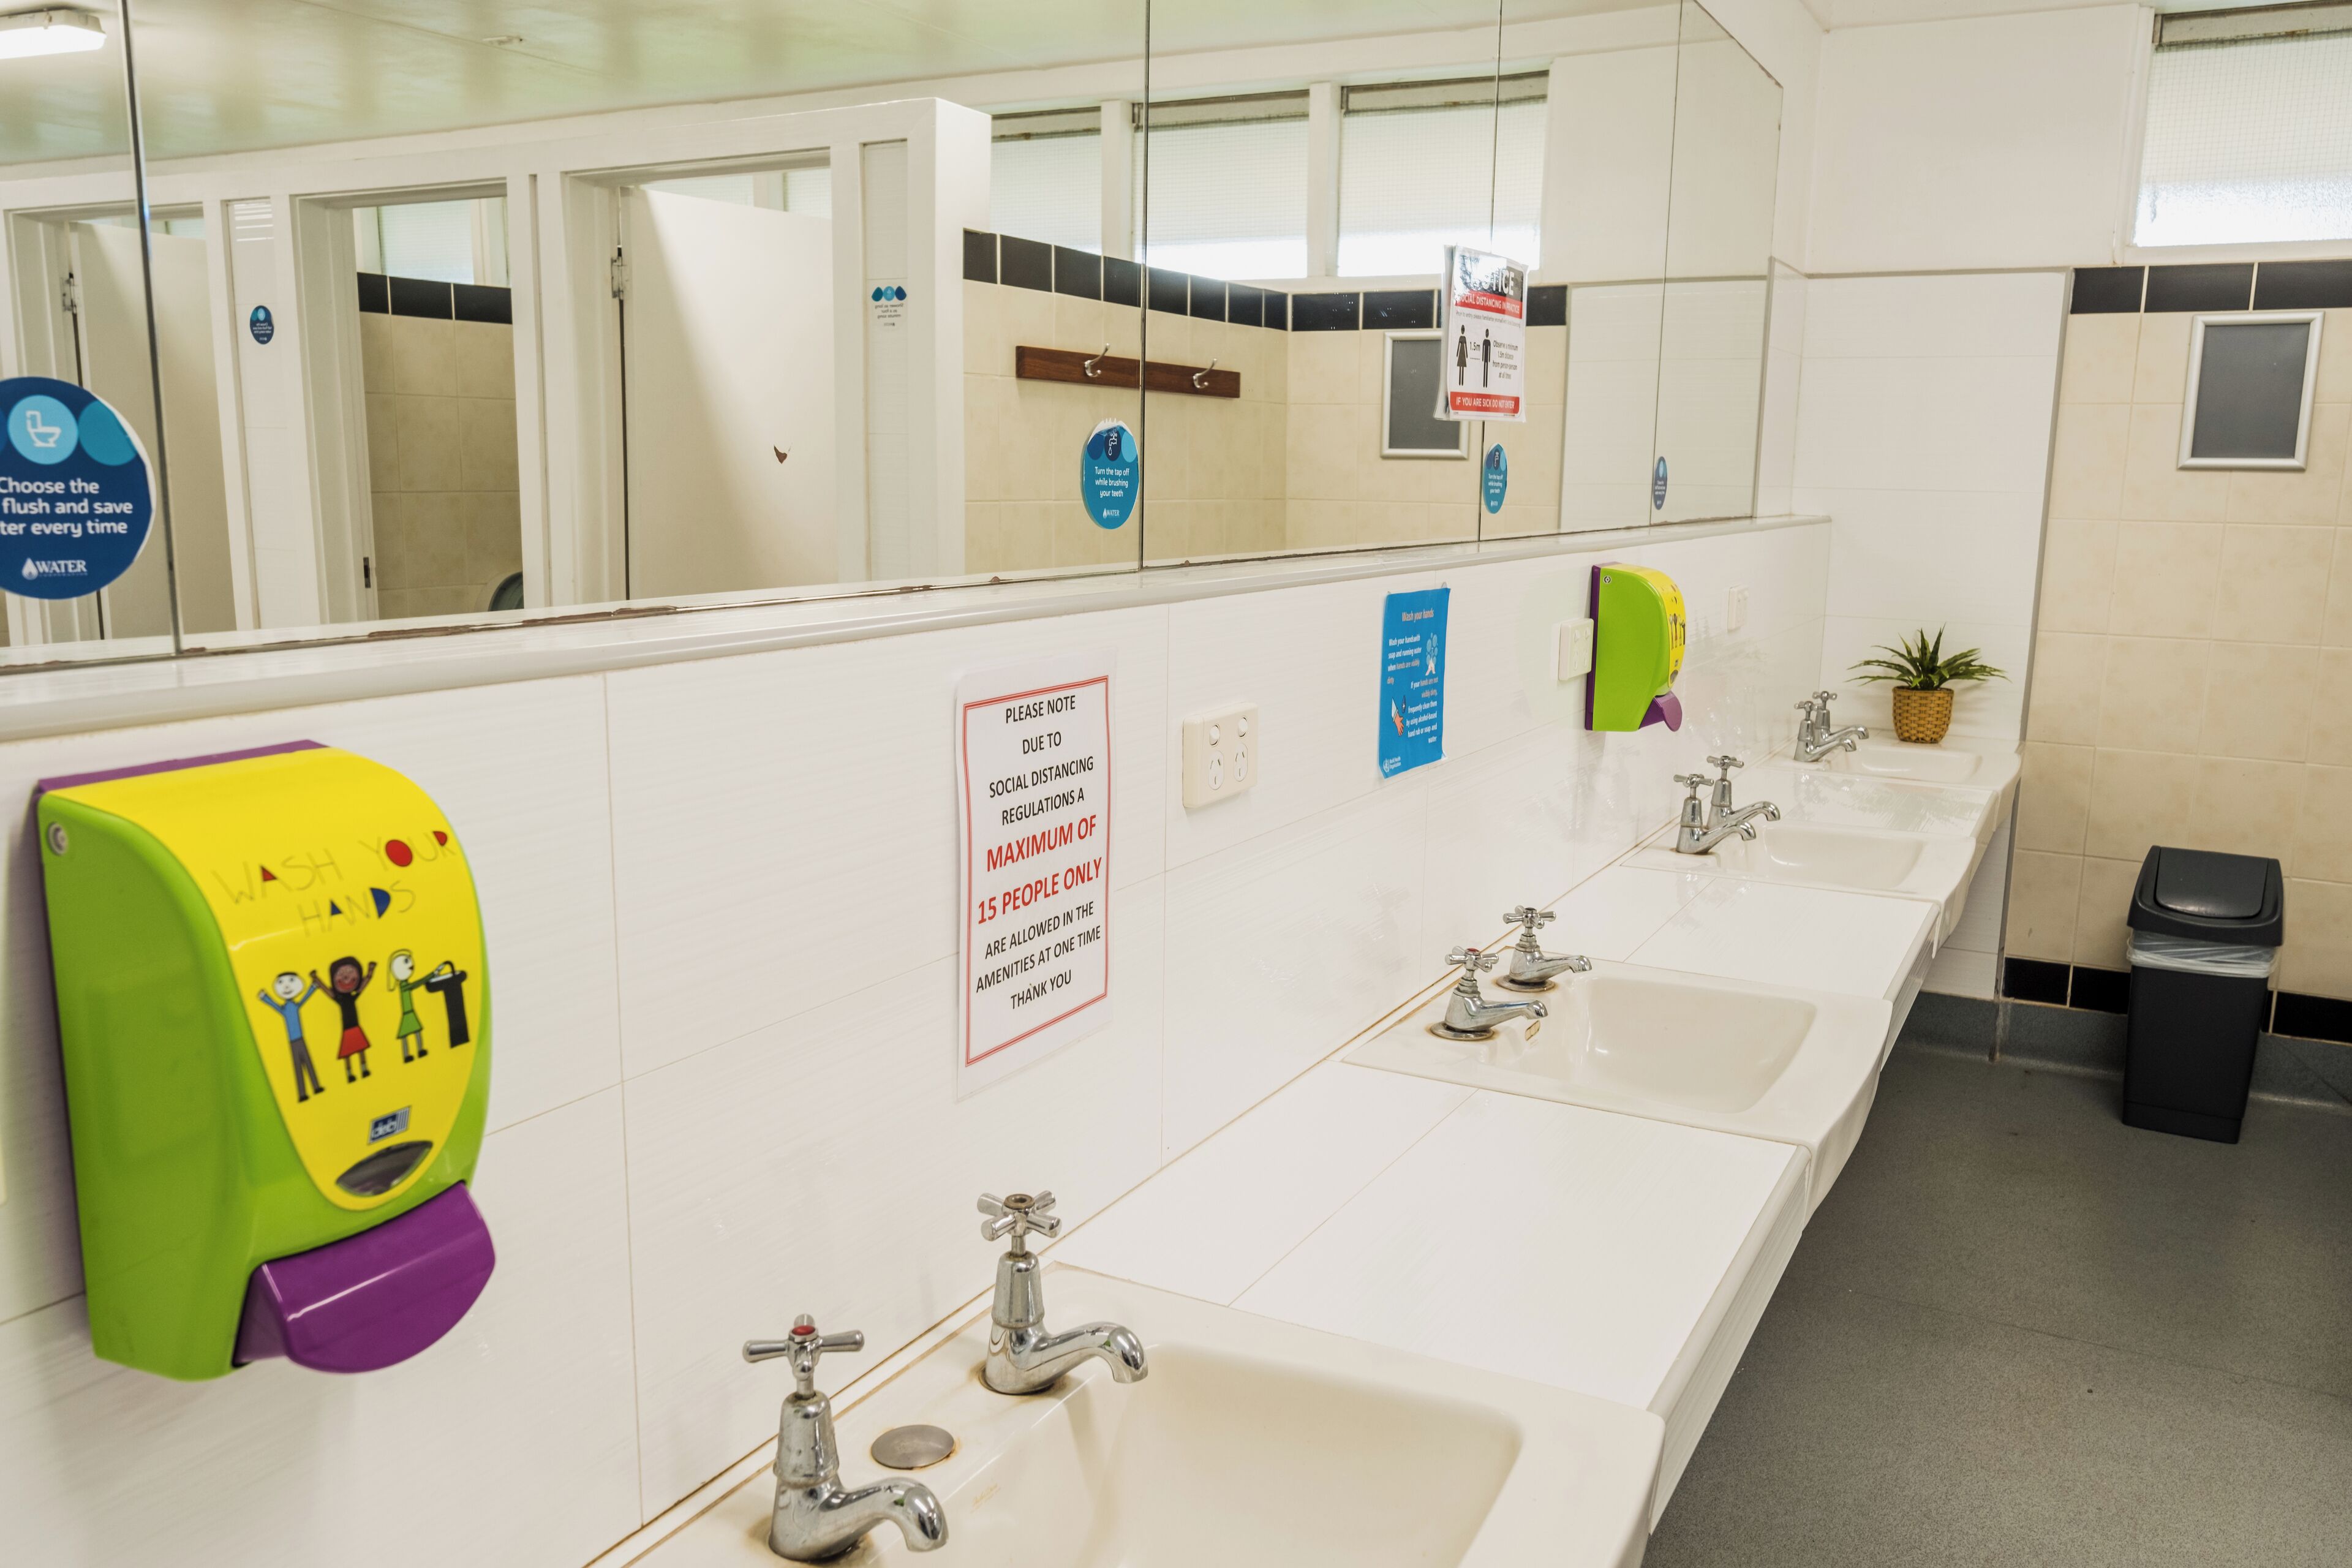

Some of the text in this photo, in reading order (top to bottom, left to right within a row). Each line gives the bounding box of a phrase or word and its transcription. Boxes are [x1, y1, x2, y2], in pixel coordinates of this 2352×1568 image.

[1474, 268, 1515, 296] OTICE
[1476, 296, 1502, 309] DISTANCING
[1502, 301, 1506, 310] IN
[1506, 302, 1520, 314] PRACTICE
[1470, 342, 1480, 351] 1.5m
[1456, 397, 1461, 405] IF
[1462, 398, 1472, 407] YOU
[1473, 398, 1482, 407] ARE
[1482, 399, 1491, 407] SICK
[1492, 399, 1498, 408] DO
[1505, 401, 1514, 409] ENTER
[0, 477, 100, 494] Choose the
[1109, 478, 1128, 488] brushing
[1112, 489, 1123, 497] teeth
[2, 497, 133, 514] flush and save
[0, 519, 127, 538] ter every time
[36, 560, 87, 573] WATER
[1402, 608, 1434, 622] Wash your hands
[1405, 635, 1414, 644] hands
[1403, 648, 1414, 657] running
[1006, 695, 1076, 724] PLEASE NOTE
[1408, 704, 1422, 714] frequently
[1406, 719, 1410, 728] by
[1023, 731, 1061, 755] DUE TO
[989, 756, 1093, 798] SOCIAL DISTANCING
[1002, 788, 1084, 826] REGULATIONS A
[987, 815, 1096, 872] MAXIMUM OF
[211, 831, 458, 905] WASH YOUR
[978, 857, 1102, 924] 15 PEOPLE ONLY
[296, 880, 417, 938] HANDS
[985, 901, 1094, 959] ARE ALLOWED IN THE
[976, 925, 1101, 993] AMENITIES AT ONE TIME
[1011, 969, 1071, 1009] THANK YOU
